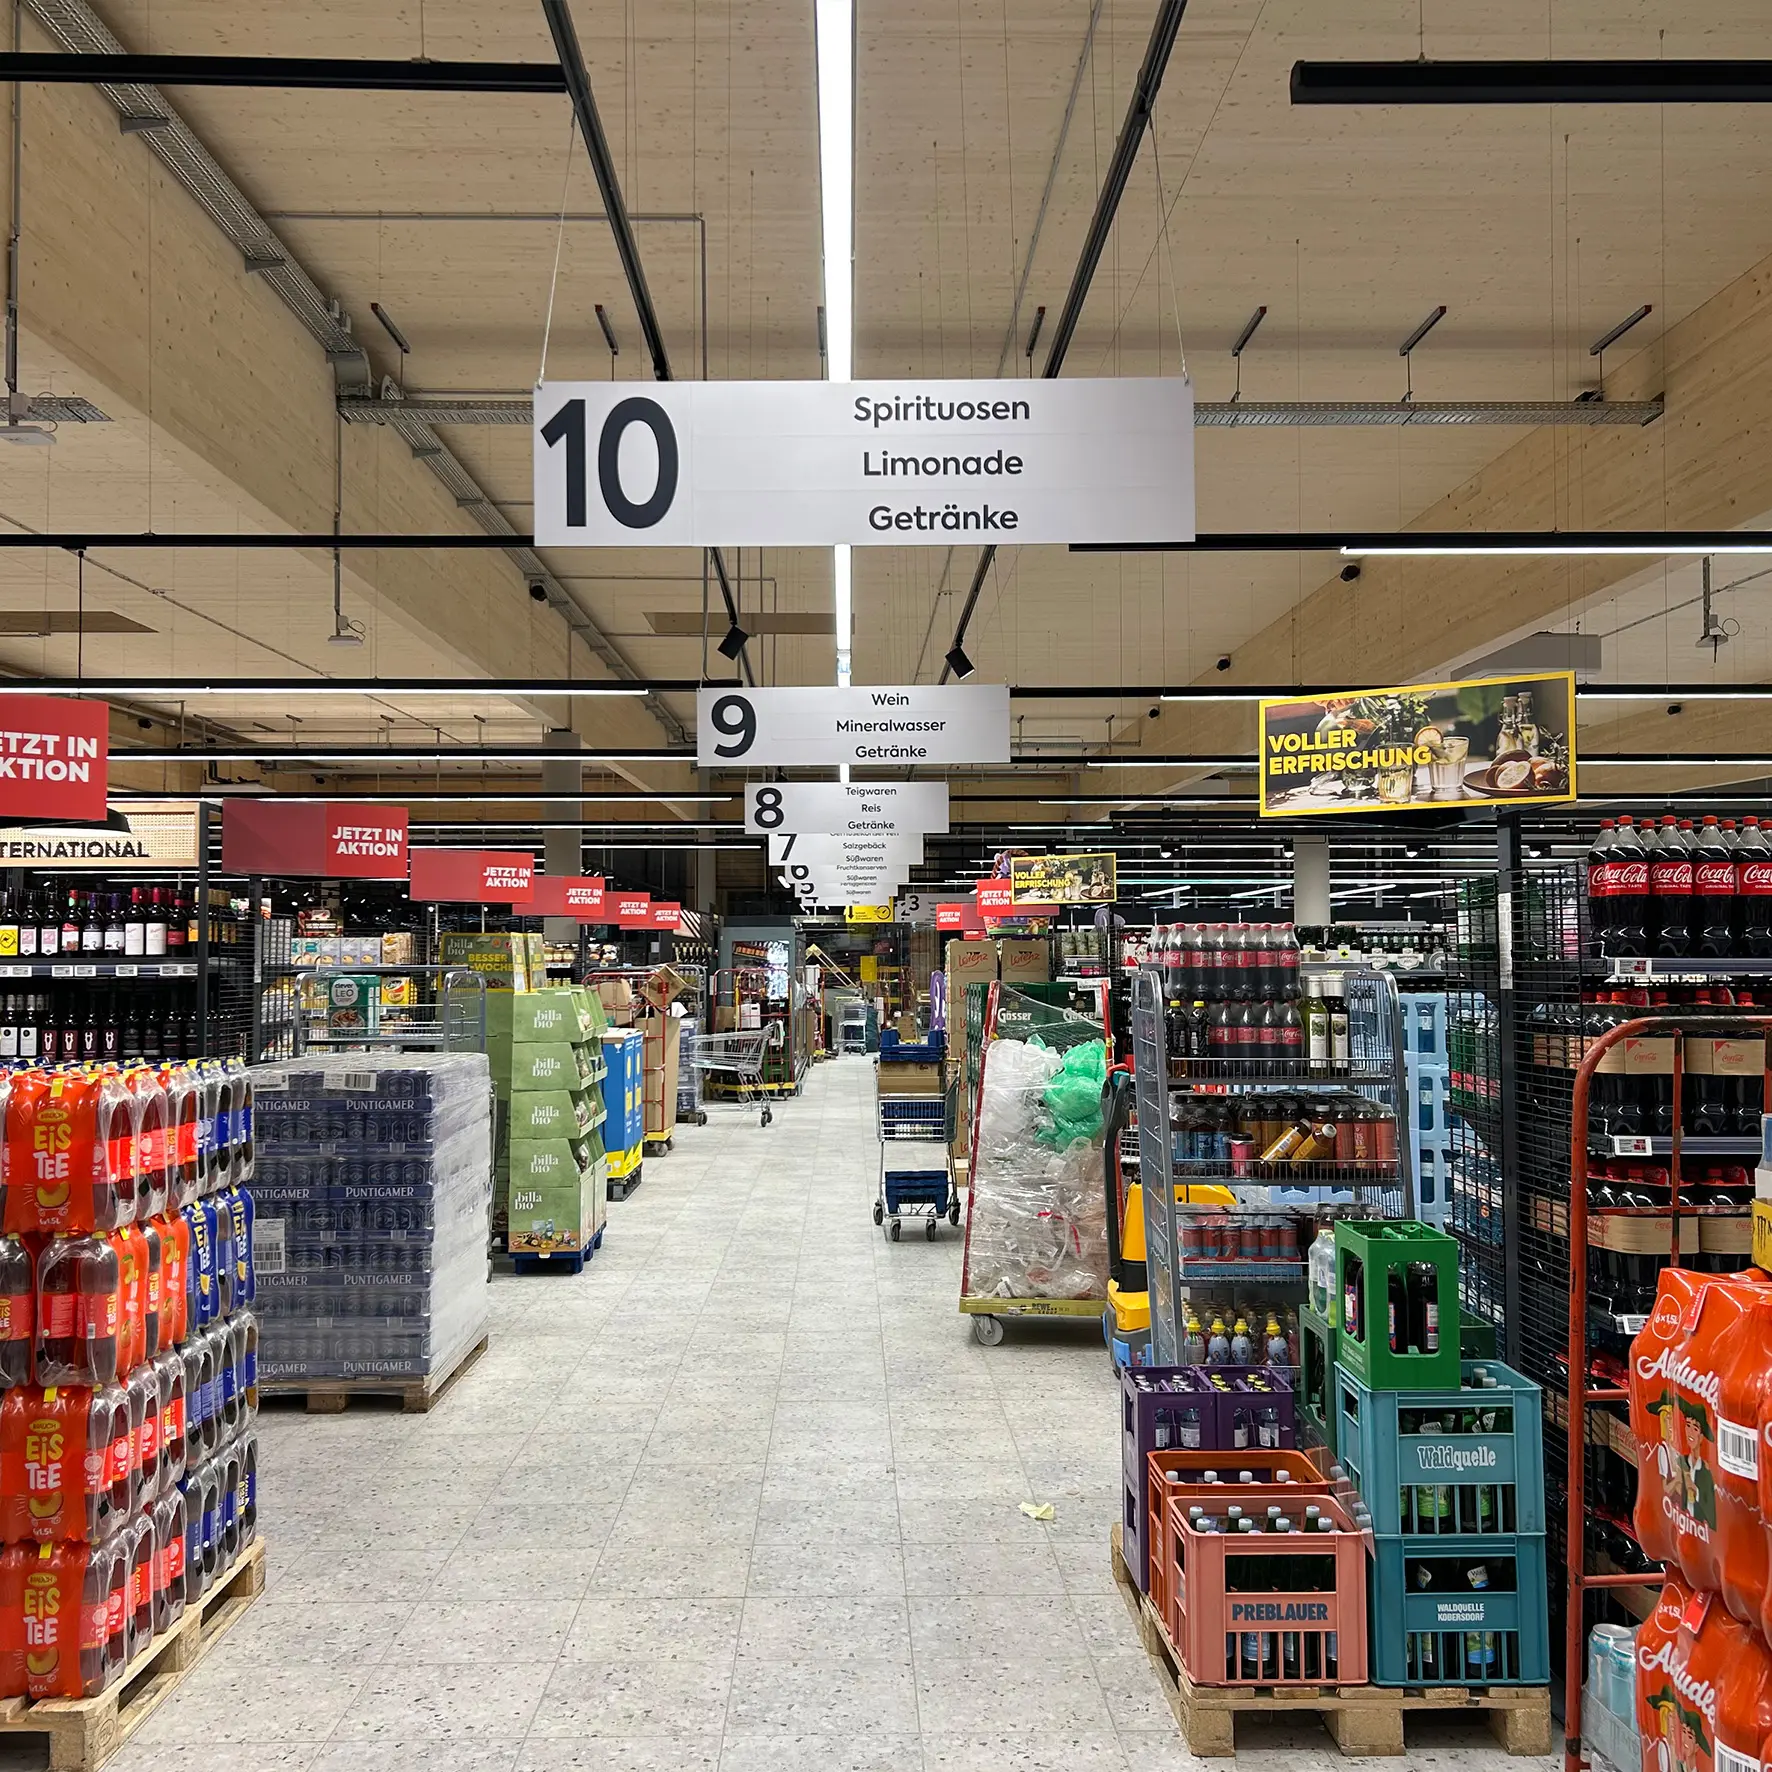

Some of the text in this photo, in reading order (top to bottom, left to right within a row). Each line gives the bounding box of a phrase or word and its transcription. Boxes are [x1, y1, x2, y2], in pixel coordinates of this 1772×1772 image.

[853, 396, 1031, 427] Spirituosen
[540, 397, 679, 530] 10
[863, 450, 1024, 477] Limonade
[868, 504, 1019, 532] Getränke
[870, 693, 910, 707] Wein
[711, 694, 757, 759] 9
[836, 719, 946, 733] Mineralwasser
[1268, 729, 1357, 753] VOLLER
[67, 737, 97, 759] IN
[855, 744, 927, 759] Getränke
[1269, 745, 1432, 776] ERFRISCHUNG
[845, 787, 897, 797] Teigwaren
[754, 787, 785, 829] 8
[861, 804, 882, 812] Reis
[848, 821, 895, 830] Getränke
[332, 826, 403, 842] JETZT IN
[336, 842, 399, 857] AKTION
[777, 833, 798, 861] 7
[843, 842, 886, 851] Salzgebäck
[845, 855, 884, 863] Süßwaren
[483, 866, 531, 878] JETZT IN
[1014, 871, 1046, 880] VOLLER
[1592, 863, 1649, 885] Coca-Cola
[485, 878, 528, 888] AKTION
[1014, 878, 1071, 889] ERFRISCHUNG
[566, 888, 602, 897] JETZT IN
[979, 890, 1003, 899] JETZT
[568, 896, 601, 905] AKTION
[619, 901, 640, 909] JETZT
[909, 895, 920, 911] 3
[981, 897, 1010, 906] AKTION
[620, 908, 647, 916] AKTION
[468, 954, 508, 962] BESSER
[958, 952, 988, 967] Lorenz
[1010, 952, 1040, 967] Lorenz
[335, 989, 354, 998] LEO
[536, 1010, 562, 1021] billa
[997, 1008, 1032, 1023] Gösser
[533, 1017, 553, 1029] bio
[535, 1058, 561, 1069] billa
[532, 1065, 552, 1077] bio
[346, 1099, 415, 1111] PUNTIGAMER
[534, 1106, 560, 1118] billa
[531, 1114, 551, 1125] bio
[33, 1151, 70, 1180] TEE
[533, 1155, 559, 1166] billa
[530, 1162, 550, 1173] bio
[345, 1186, 415, 1198] PUNTIGAMER
[517, 1192, 542, 1203] billa
[514, 1198, 534, 1210] bio
[344, 1274, 412, 1286] PUNTIGAMER
[343, 1361, 412, 1372] PUNTIGAMER
[1417, 1445, 1496, 1471] Waldquelle
[24, 1462, 62, 1490] TEE
[1662, 1495, 1710, 1544] Original
[1232, 1603, 1329, 1621] PREBLAUER
[1437, 1603, 1485, 1612] WALDQUELLE
[1437, 1613, 1485, 1622] KOBERSDORF
[23, 1615, 59, 1645] TEE
